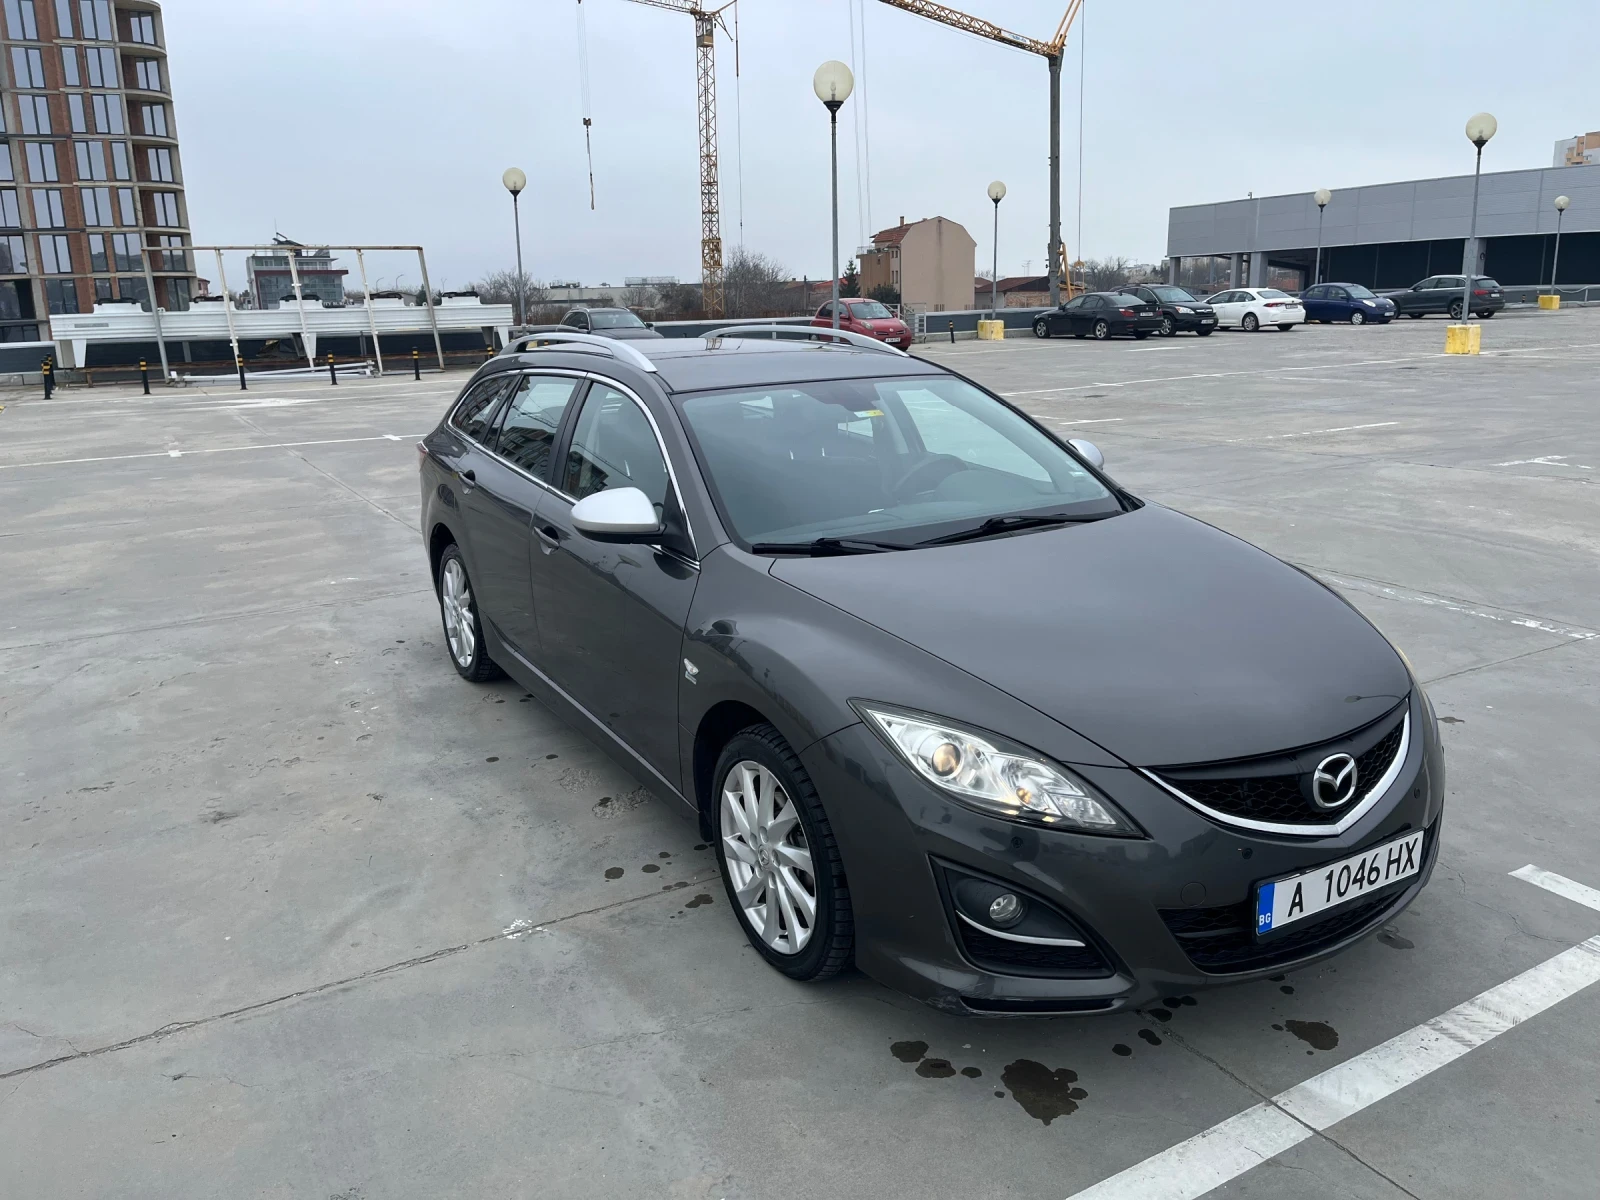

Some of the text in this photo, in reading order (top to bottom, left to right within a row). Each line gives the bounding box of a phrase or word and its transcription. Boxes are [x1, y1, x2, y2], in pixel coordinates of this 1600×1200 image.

[1287, 837, 1419, 917] A 1046 HX
[1258, 912, 1271, 926] BG
